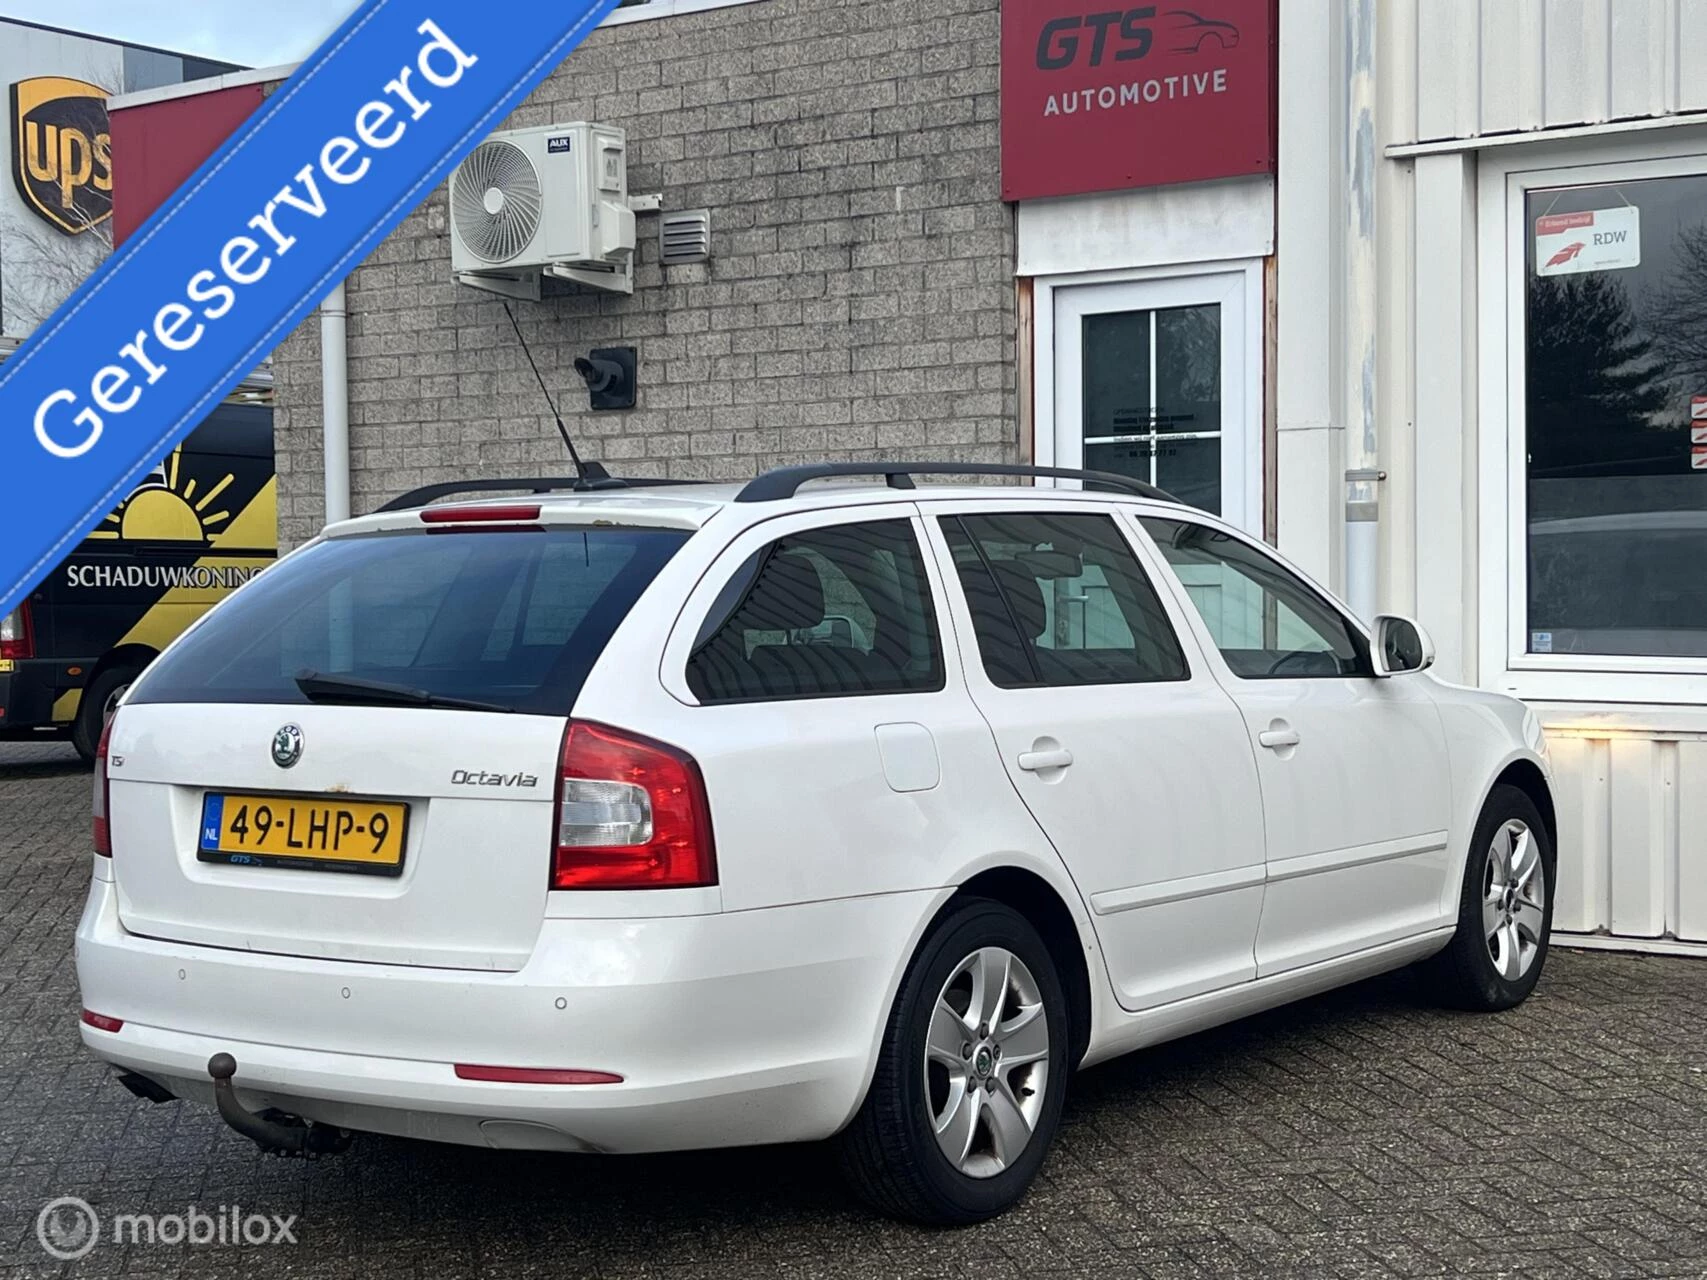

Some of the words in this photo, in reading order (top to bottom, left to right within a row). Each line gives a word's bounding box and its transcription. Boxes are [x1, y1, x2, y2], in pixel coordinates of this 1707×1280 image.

[1035, 6, 1157, 71] GTS
[1044, 69, 1227, 117] AUTOMOTIVE
[1592, 230, 1628, 246] RDW
[450, 769, 539, 788] Octavia
[204, 828, 219, 841] NL
[229, 804, 390, 854] 49-LHP-9
[230, 854, 251, 864] GTS
